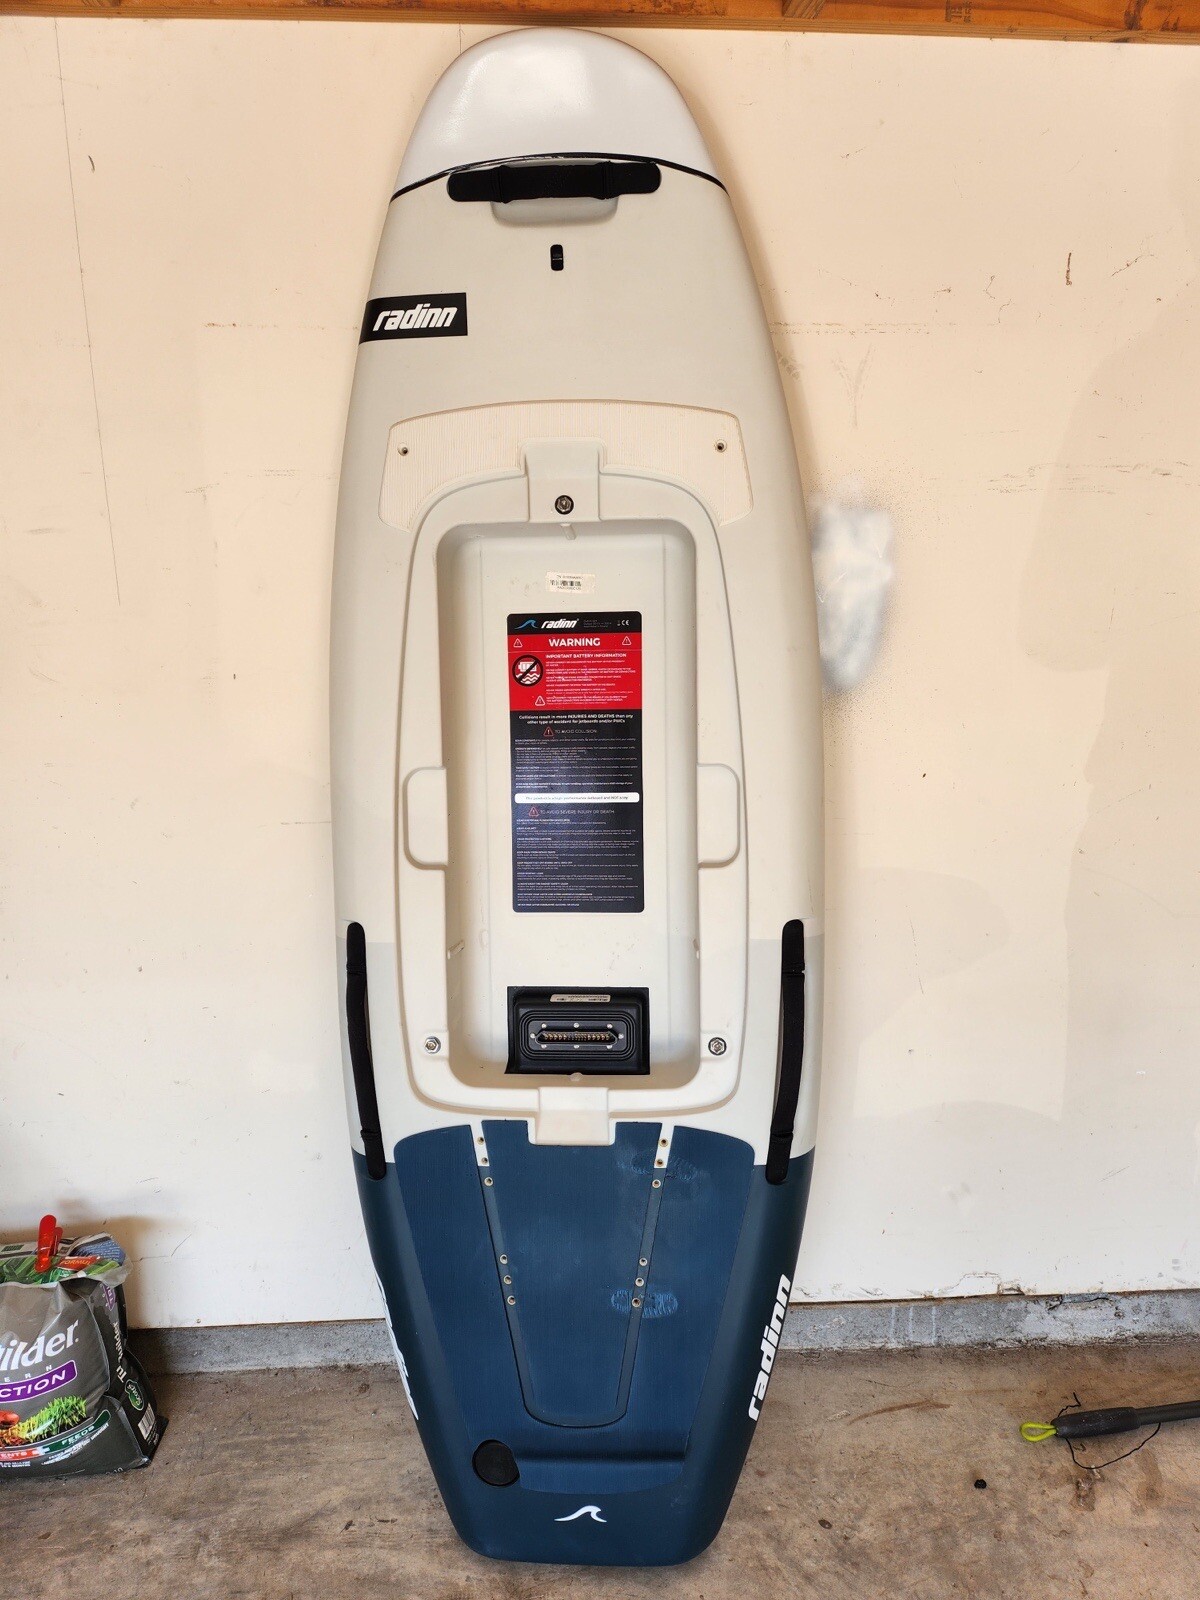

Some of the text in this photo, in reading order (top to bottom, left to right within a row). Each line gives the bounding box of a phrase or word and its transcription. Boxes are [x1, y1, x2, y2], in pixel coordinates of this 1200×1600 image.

[372, 303, 458, 332] radinn
[541, 618, 578, 629] radinn
[548, 637, 601, 647] WARNING
[748, 1273, 792, 1421] radinn
[62, 1425, 95, 1445] FEEDS
